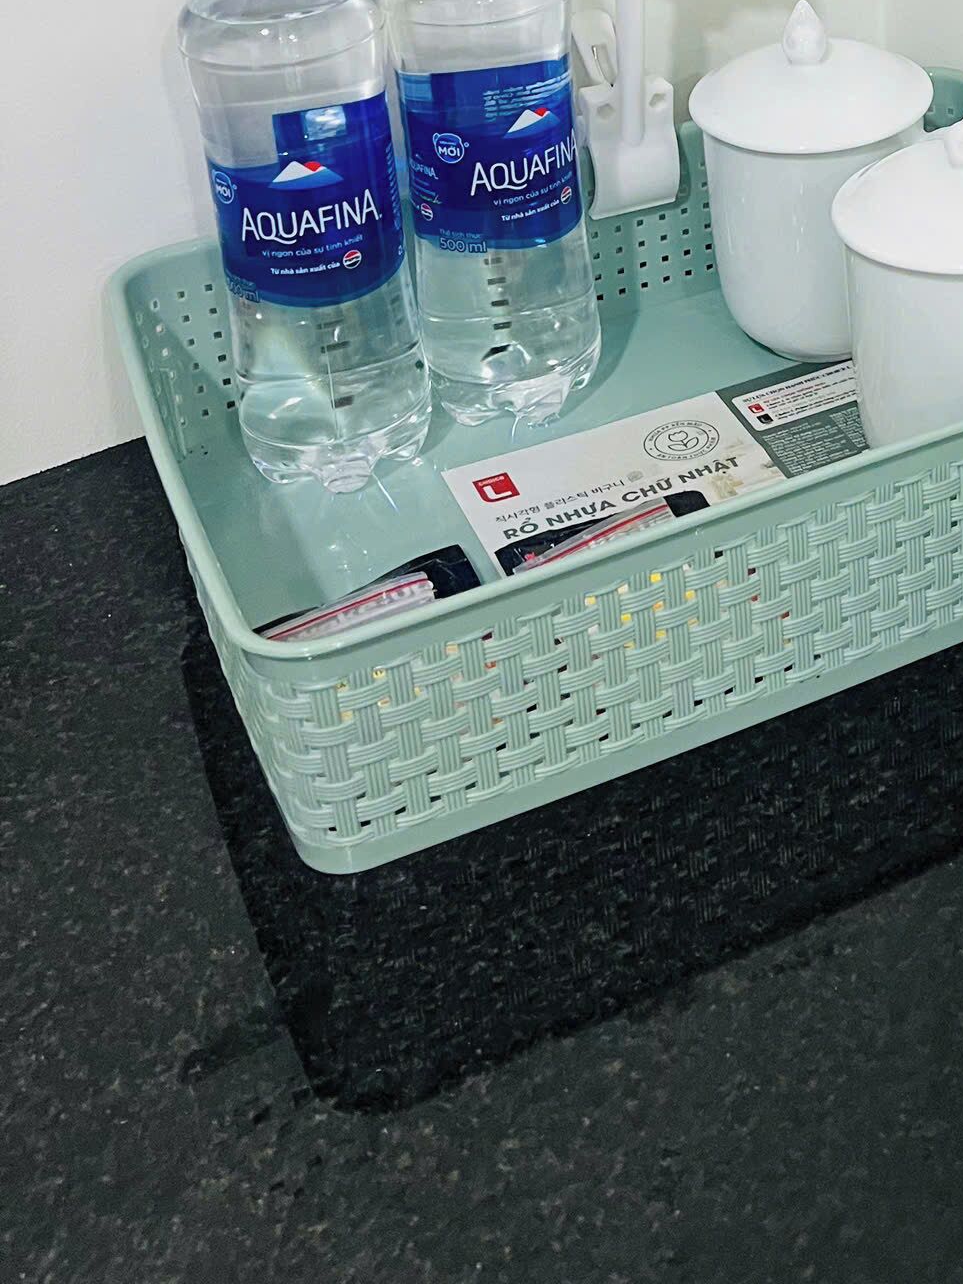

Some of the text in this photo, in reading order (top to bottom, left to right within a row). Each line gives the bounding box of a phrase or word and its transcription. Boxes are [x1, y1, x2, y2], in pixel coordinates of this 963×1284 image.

[241, 188, 379, 245] AQUAFINA
[440, 237, 488, 253] 500 ml
[482, 485, 513, 500] L
[503, 456, 739, 540] RỔ NHỰA CHỮ NHẬT
